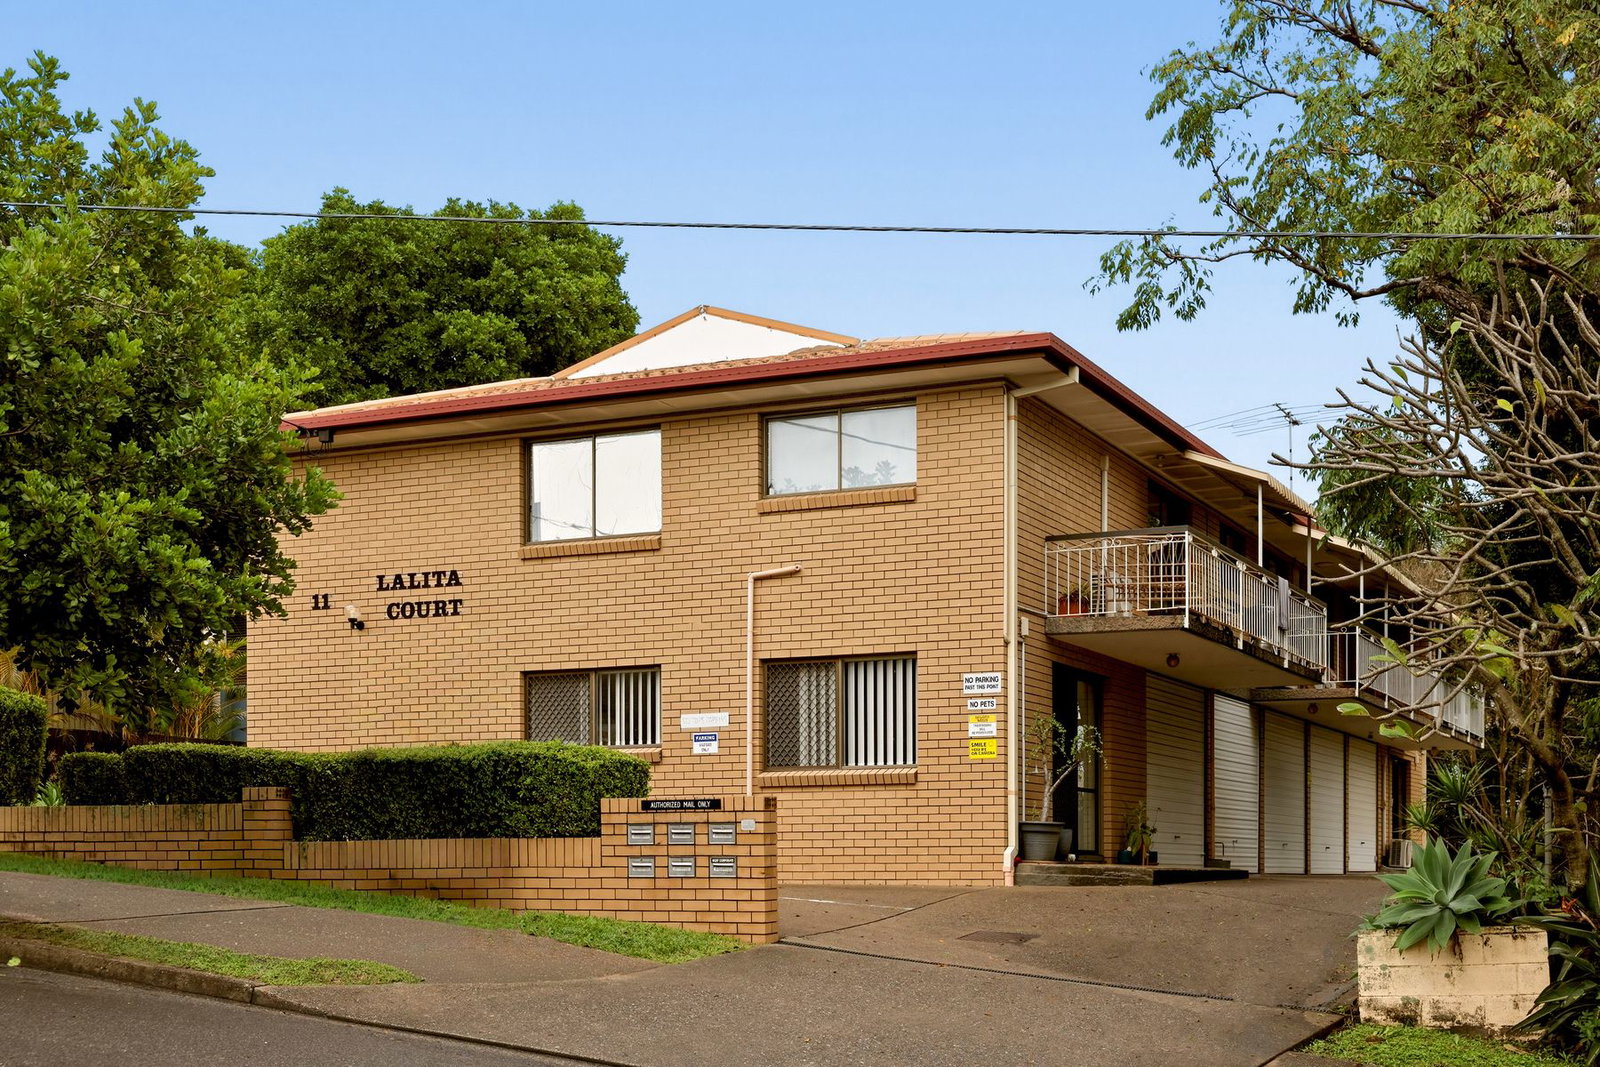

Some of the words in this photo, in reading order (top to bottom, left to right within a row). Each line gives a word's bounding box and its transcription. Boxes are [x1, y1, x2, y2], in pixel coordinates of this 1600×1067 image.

[376, 570, 462, 591] LALITA
[312, 593, 330, 610] 11
[387, 599, 462, 619] COURT
[965, 676, 974, 684] NO
[975, 675, 999, 683] PARKING
